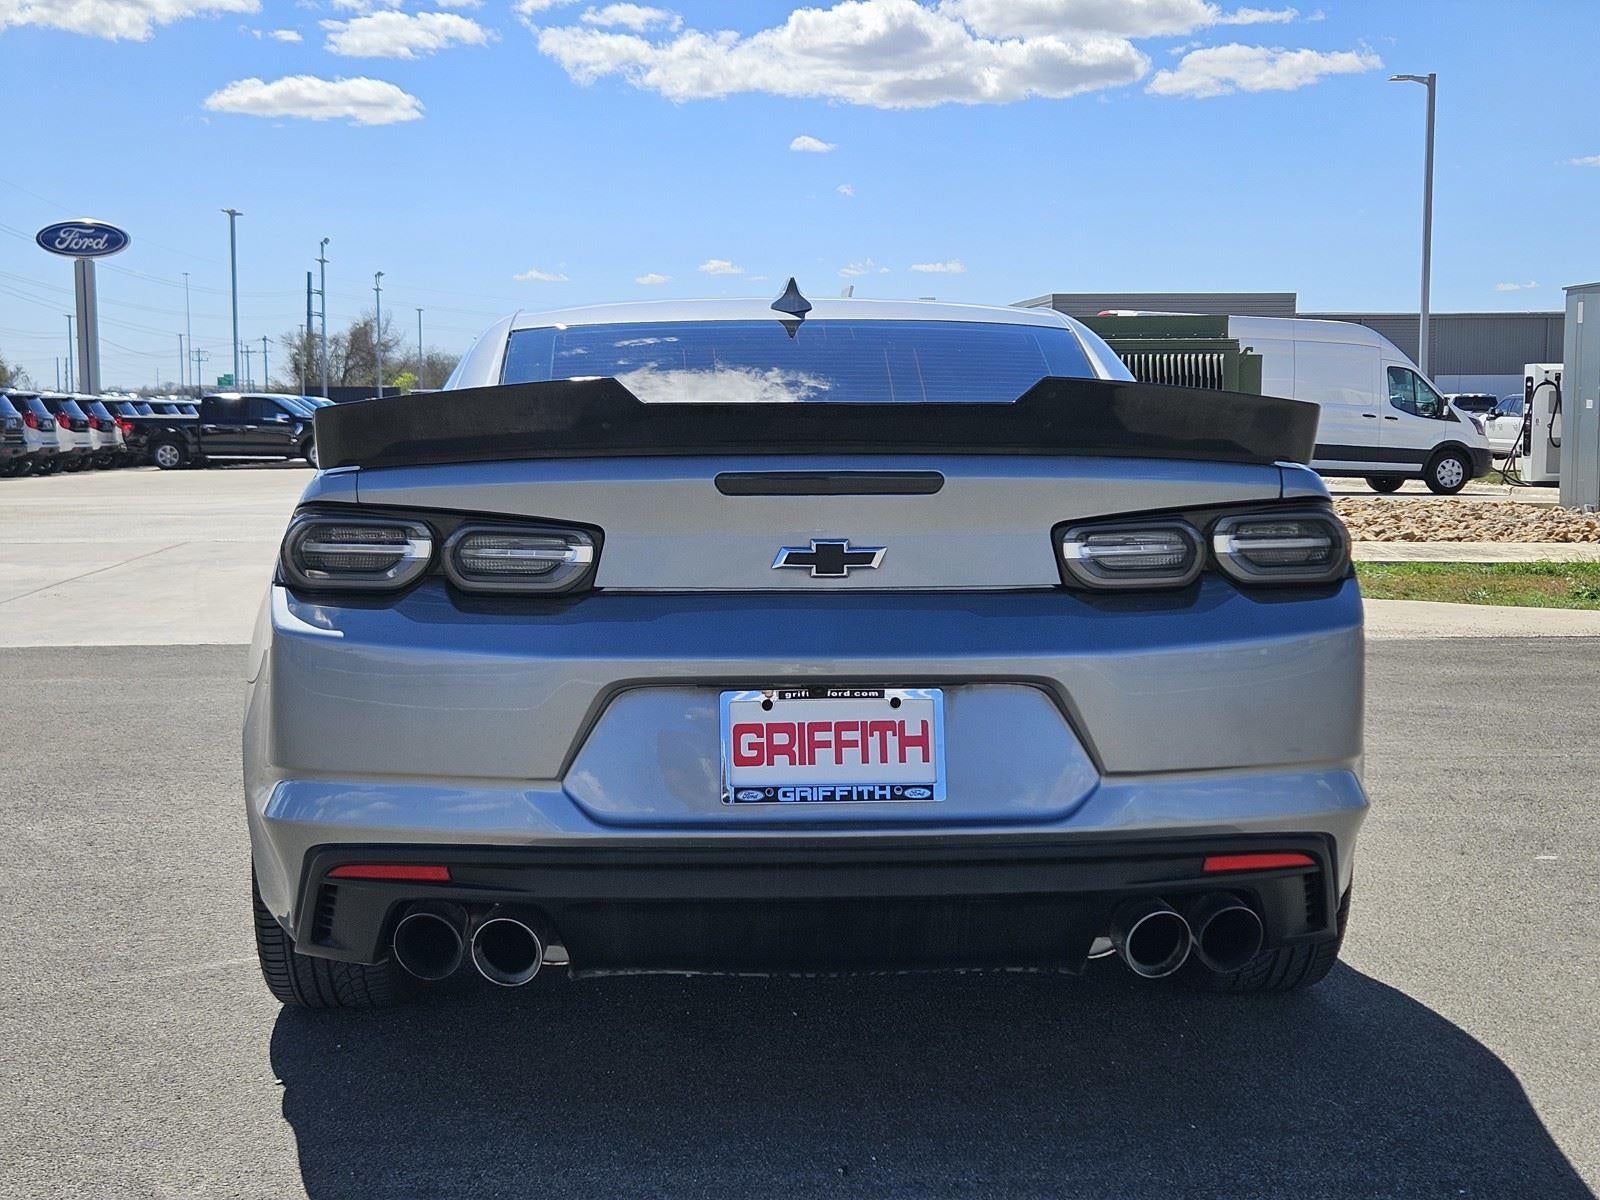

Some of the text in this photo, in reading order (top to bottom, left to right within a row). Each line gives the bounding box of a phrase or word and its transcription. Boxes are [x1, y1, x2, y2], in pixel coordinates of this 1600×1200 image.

[55, 227, 108, 249] Ford
[732, 720, 930, 767] GRIFFITH
[778, 785, 891, 801] GRIFFITH
